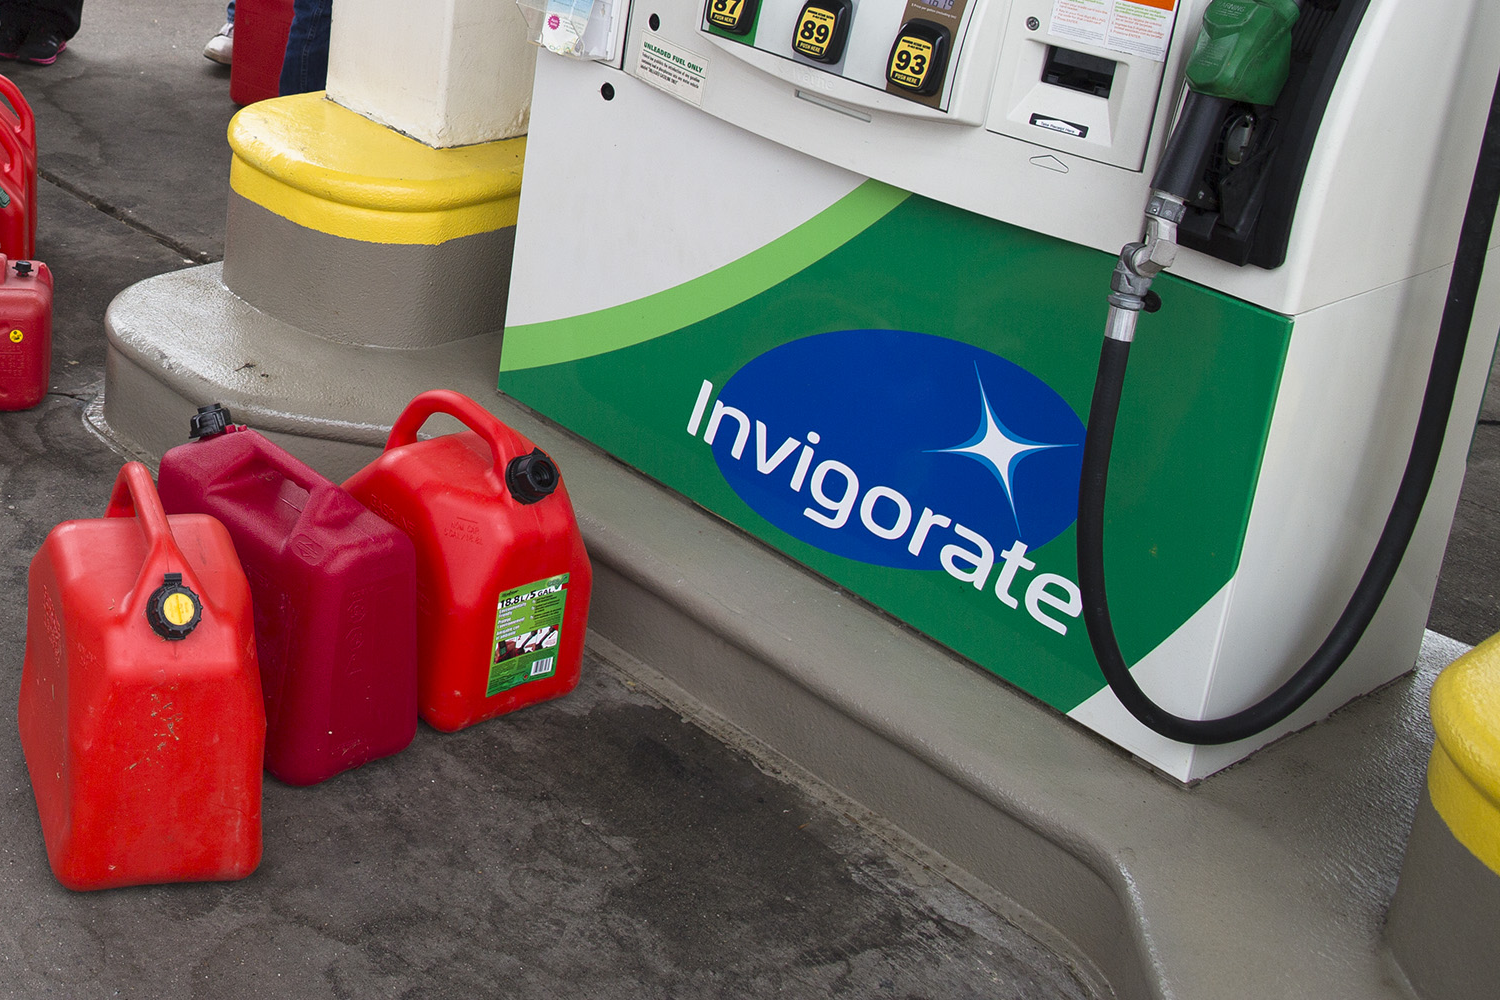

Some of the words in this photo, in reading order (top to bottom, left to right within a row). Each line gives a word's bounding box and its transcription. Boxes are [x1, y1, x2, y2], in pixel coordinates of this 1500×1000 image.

[800, 20, 830, 44] 89
[644, 41, 672, 61] UNLEADED
[672, 55, 687, 66] FUEL
[687, 60, 704, 74] ONLY
[895, 50, 927, 76] 93
[1050, 124, 1065, 132] Receipt
[686, 379, 1084, 637] Invigorate
[537, 588, 555, 596] GAL.
